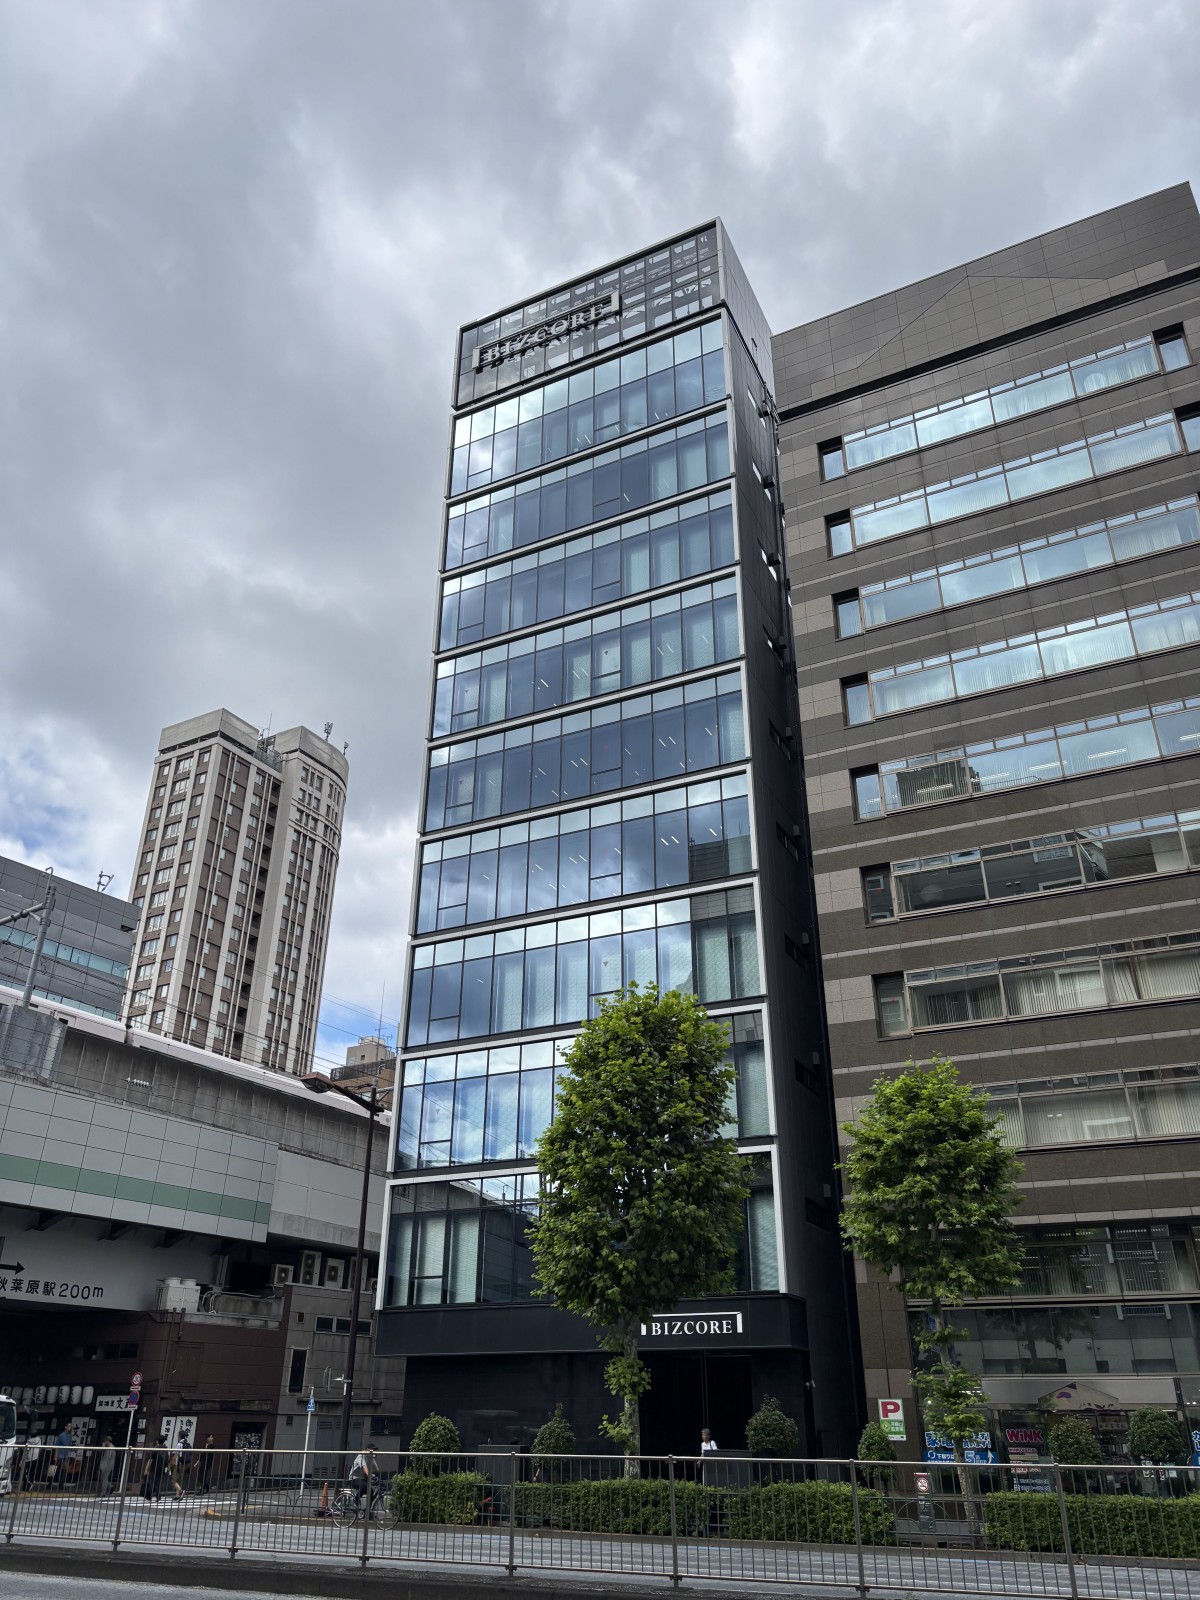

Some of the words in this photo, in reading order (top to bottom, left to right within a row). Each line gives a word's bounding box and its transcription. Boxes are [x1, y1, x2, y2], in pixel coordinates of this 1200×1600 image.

[487, 304, 604, 362] BIZCORE
[0, 1276, 104, 1300] 秋葉原駅200m
[651, 1320, 733, 1336] BIZCORE
[881, 1401, 900, 1418] P
